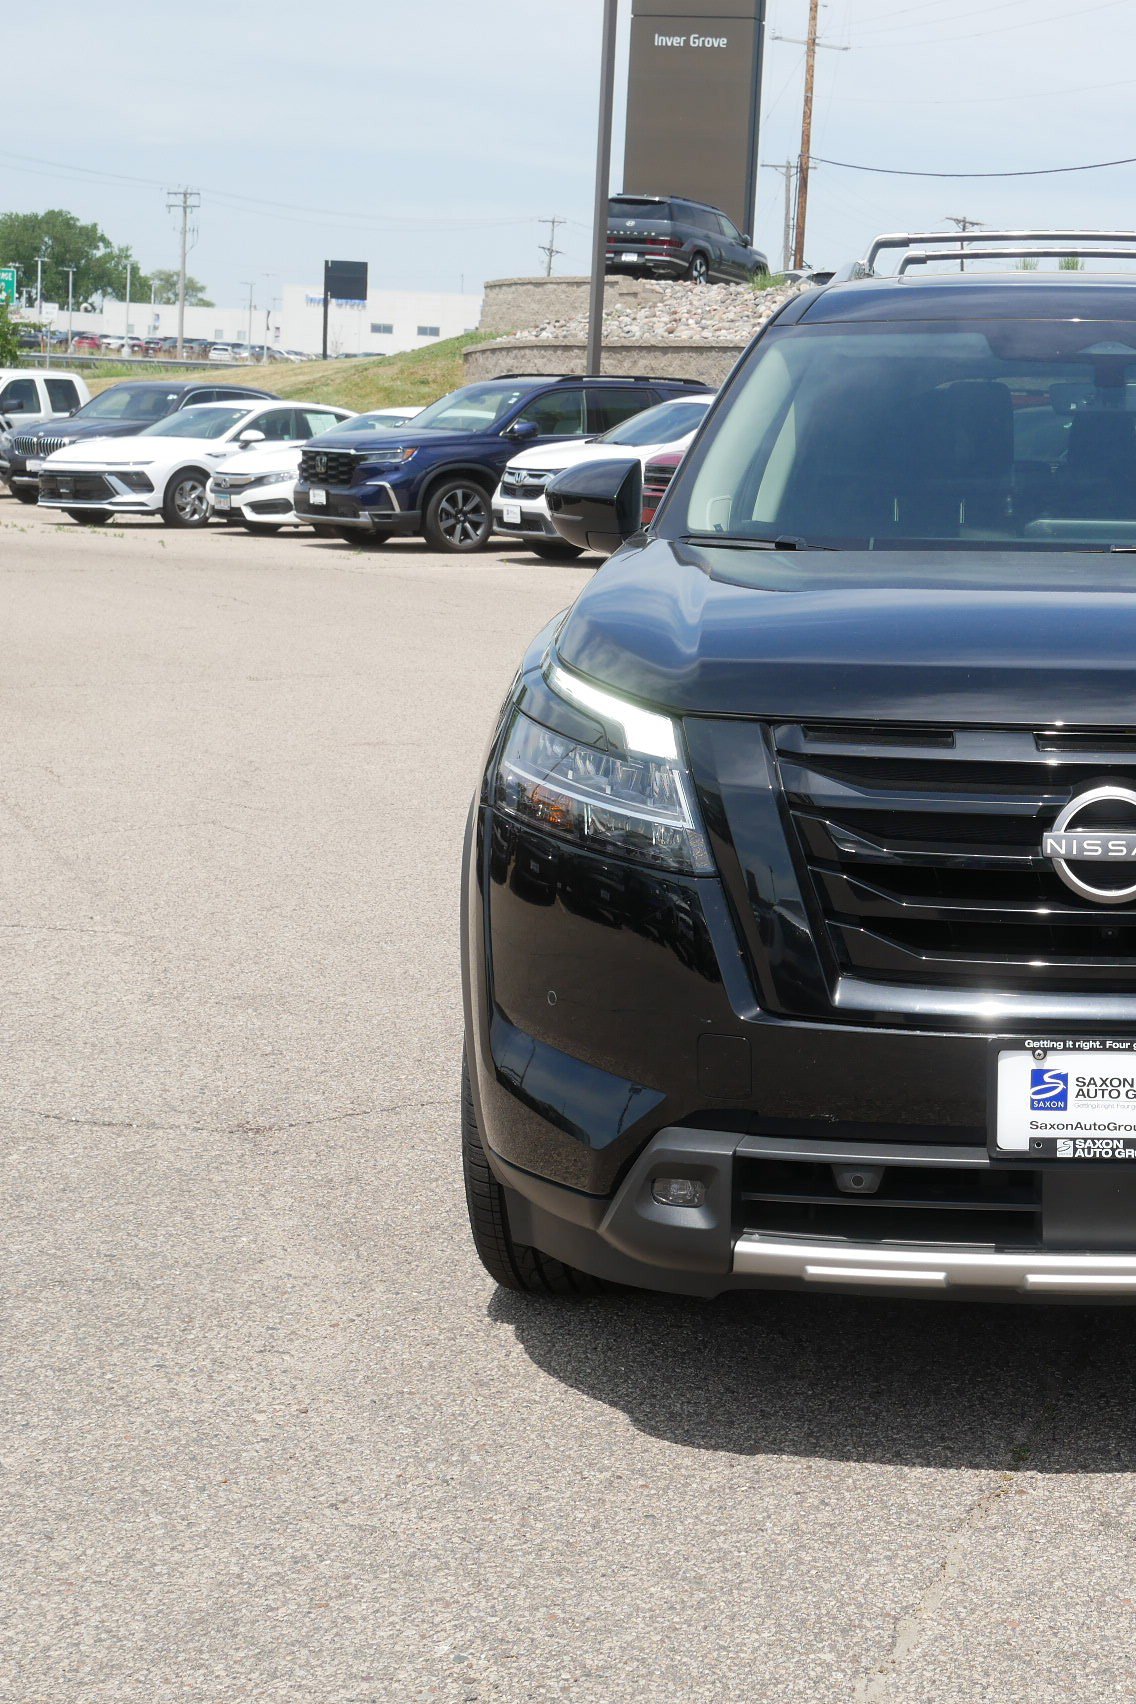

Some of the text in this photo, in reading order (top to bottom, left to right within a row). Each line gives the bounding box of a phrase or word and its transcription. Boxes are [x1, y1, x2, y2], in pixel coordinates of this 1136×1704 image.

[654, 33, 728, 48] Inver Grove
[1024, 1039, 1064, 1050] Getting
[1066, 1040, 1074, 1049] it
[1075, 1040, 1103, 1050] right.
[1105, 1040, 1131, 1049] Four
[1075, 1076, 1135, 1088] SAXON
[1074, 1088, 1121, 1100] AUTO
[1033, 1100, 1065, 1108] SAXON
[1075, 1139, 1124, 1149] SAXON
[1074, 1149, 1113, 1158] AUTO
